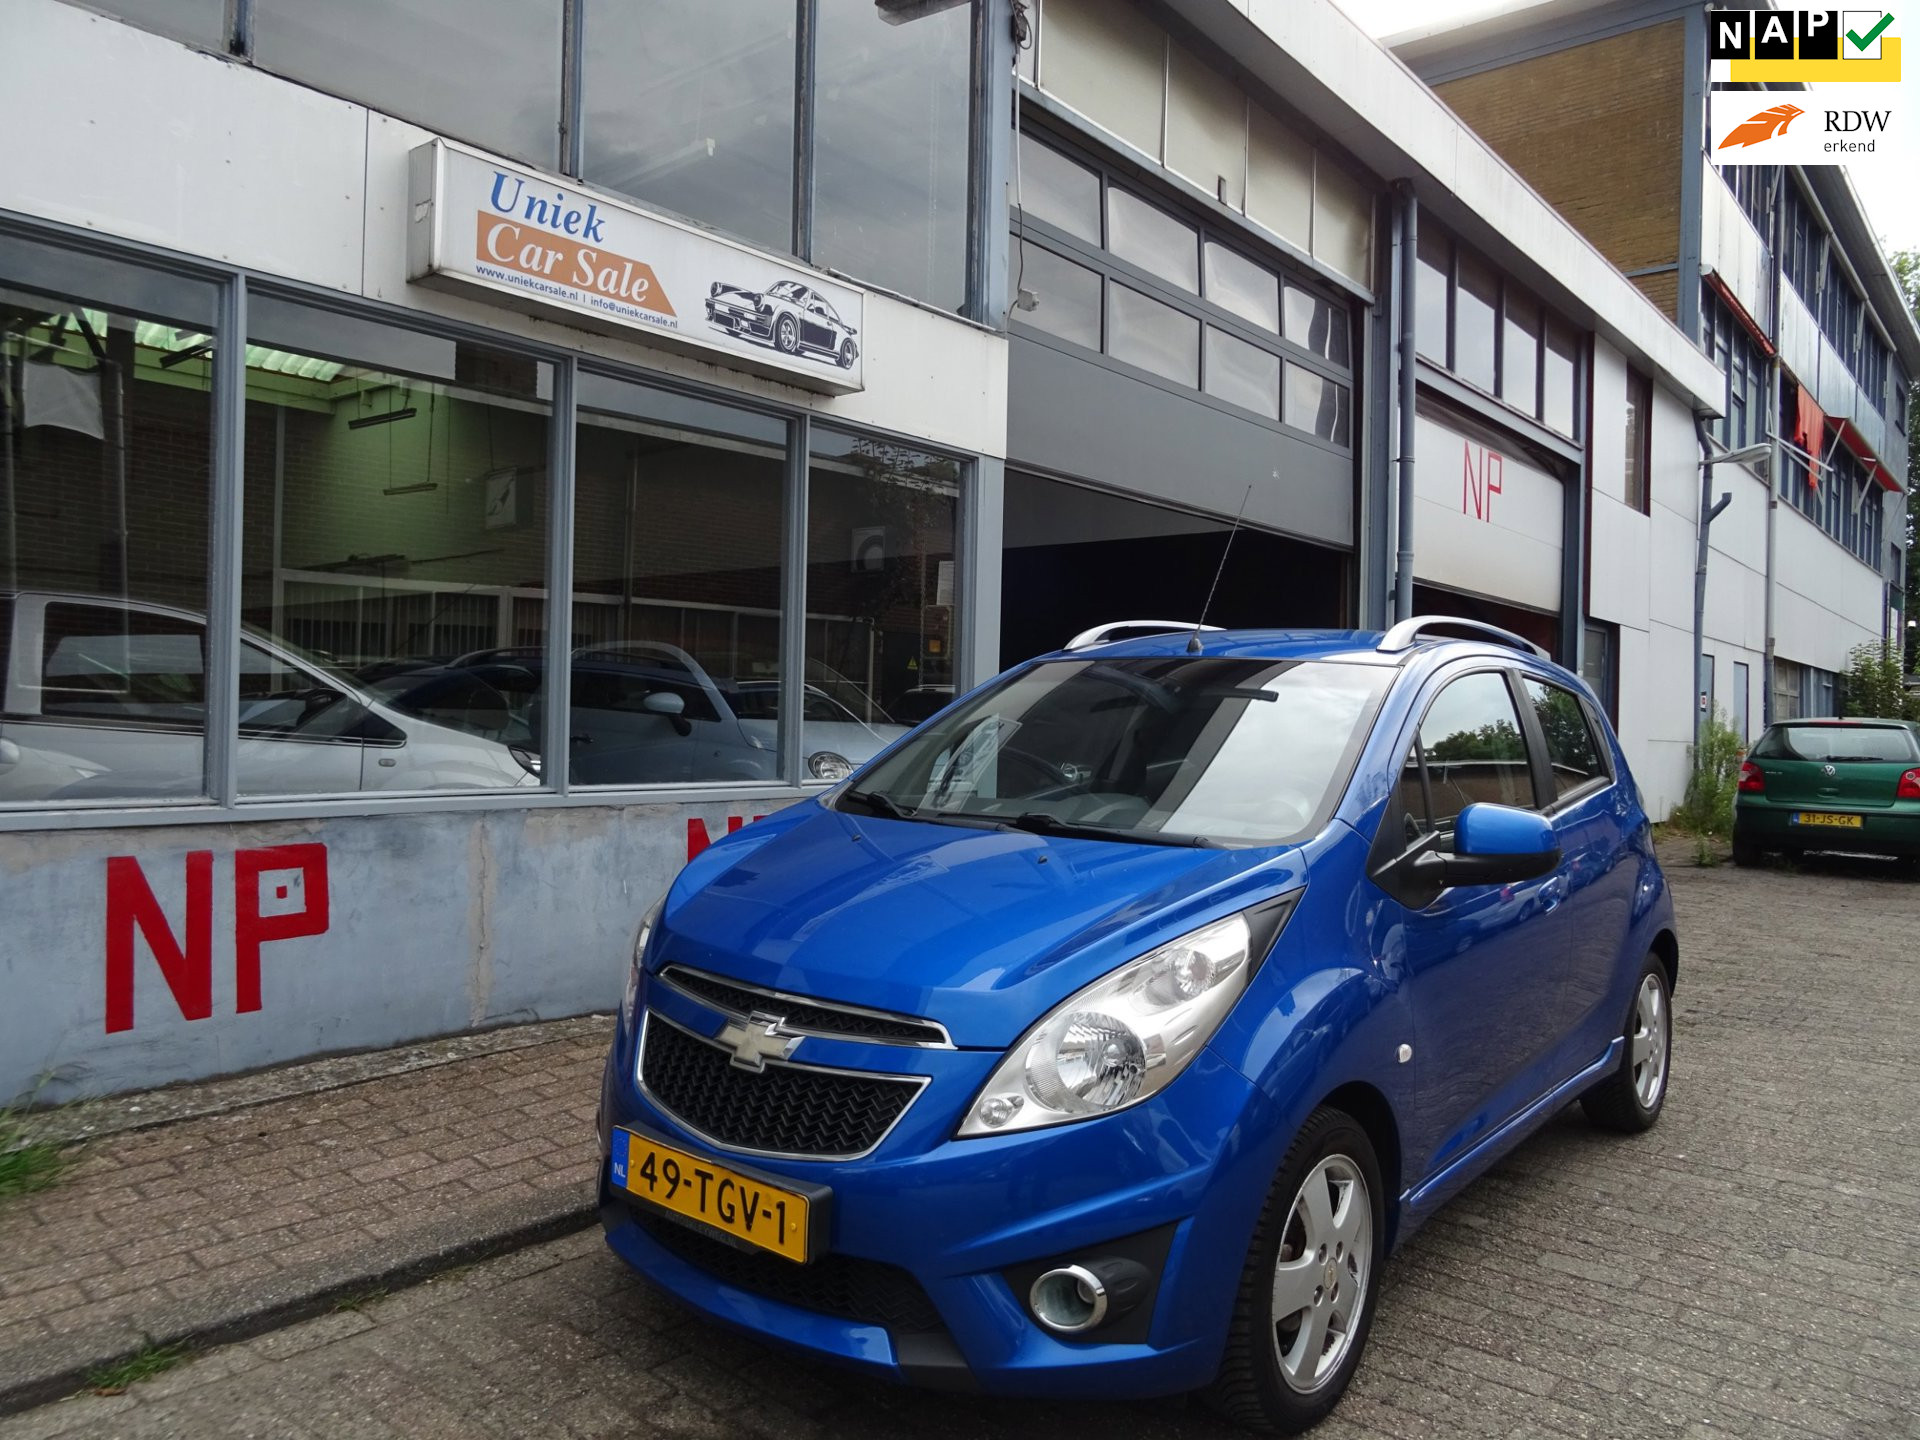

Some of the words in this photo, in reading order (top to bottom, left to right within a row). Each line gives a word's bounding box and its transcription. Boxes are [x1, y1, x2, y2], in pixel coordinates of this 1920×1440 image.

[490, 171, 605, 243] Uniek
[475, 264, 579, 302] www.uniekcarsale.nl
[590, 296, 679, 330] info@uniekcarsale.nl
[487, 222, 564, 276] Car
[572, 248, 650, 303] Sale
[1463, 439, 1503, 523] NP
[1804, 814, 1854, 825] 31-JS-GK
[105, 842, 329, 1034] NP
[614, 1162, 626, 1178] NL
[639, 1151, 786, 1246] 49-TGV-1
